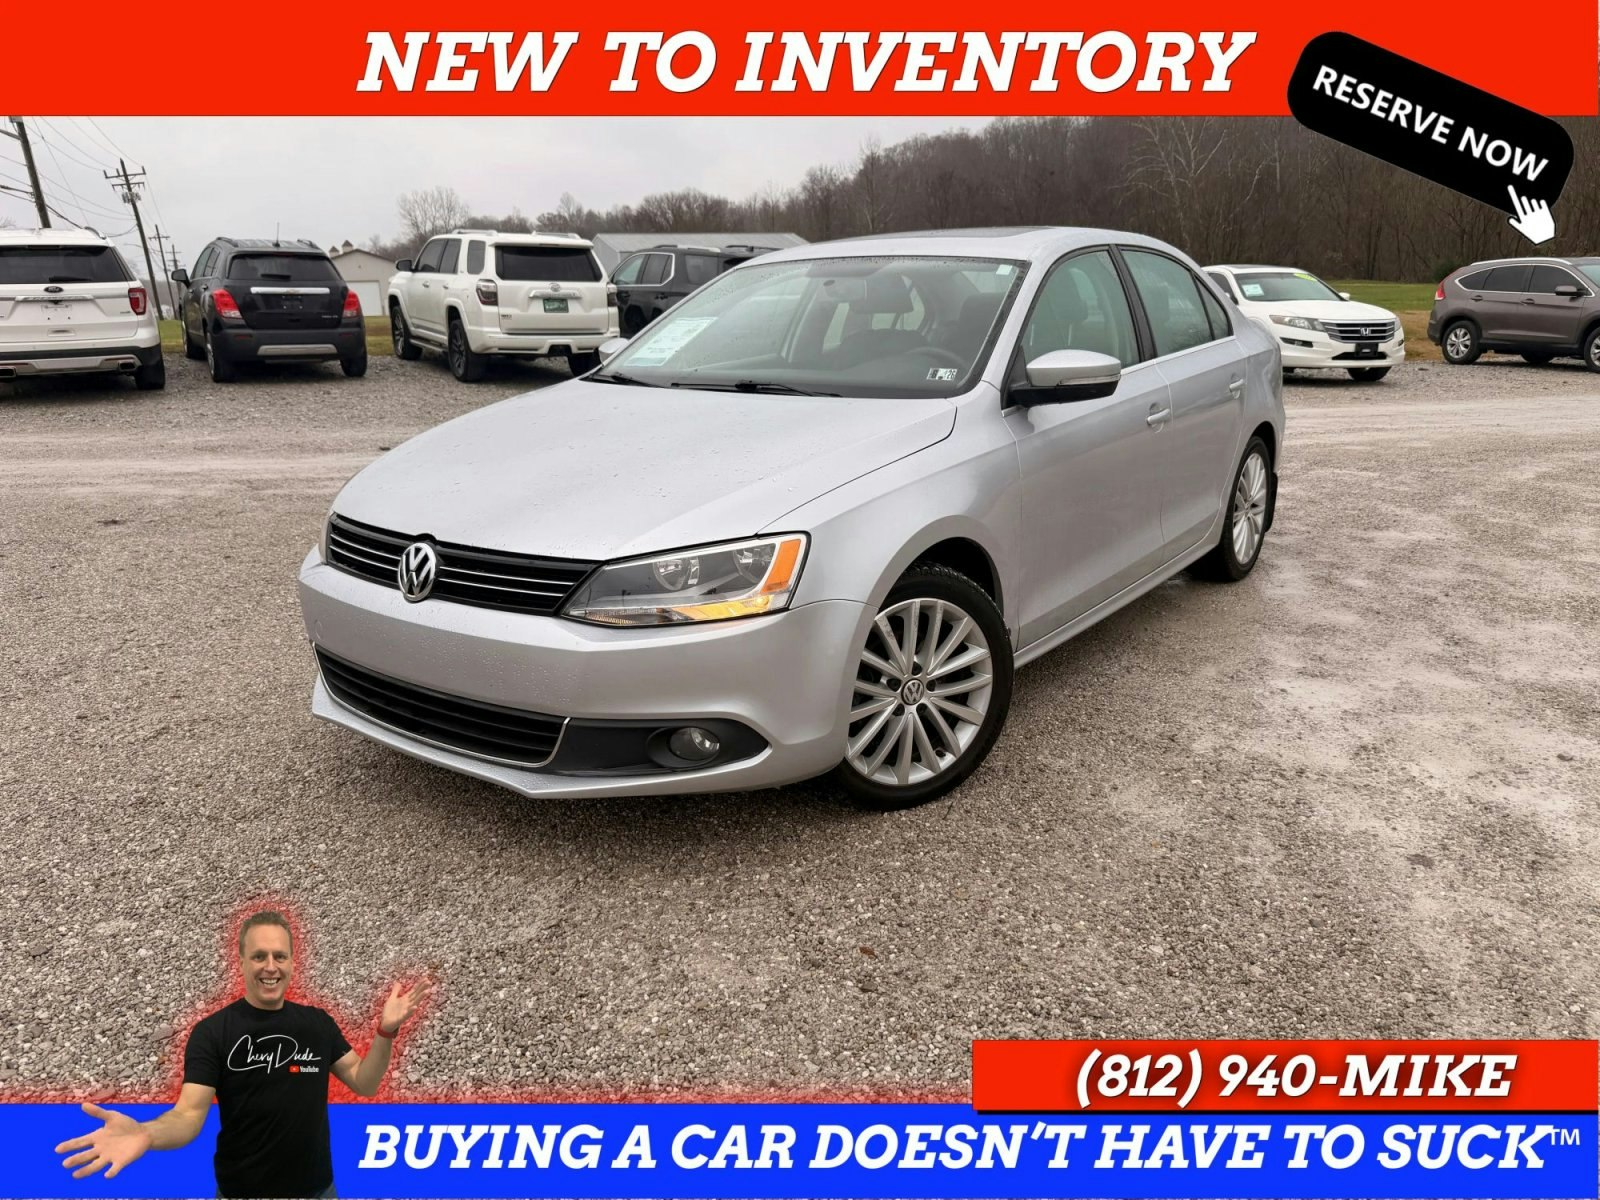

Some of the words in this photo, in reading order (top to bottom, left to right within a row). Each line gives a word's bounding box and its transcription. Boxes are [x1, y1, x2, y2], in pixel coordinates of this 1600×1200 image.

[227, 1034, 274, 1074] Chevy
[256, 1034, 322, 1068] Dude
[299, 1065, 319, 1073] YouTube
